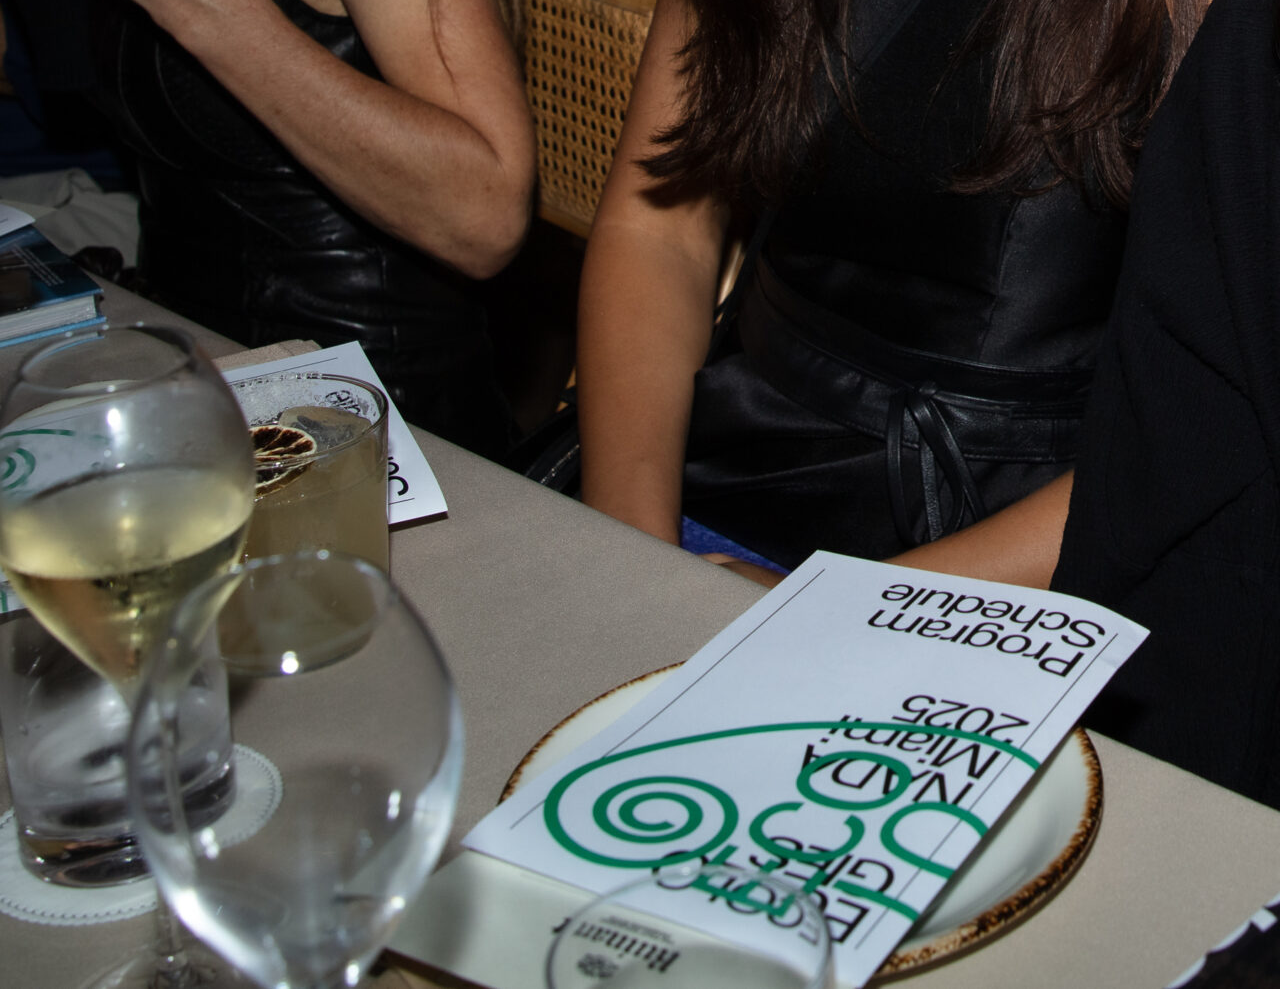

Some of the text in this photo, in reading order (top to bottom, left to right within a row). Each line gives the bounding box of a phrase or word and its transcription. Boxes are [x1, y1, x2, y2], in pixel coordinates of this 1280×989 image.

[867, 609, 1085, 678] Program
[881, 584, 1106, 648] Schedule
[820, 715, 1002, 780] Miami
[891, 695, 1030, 745] 2025
[801, 744, 974, 807] NADA
